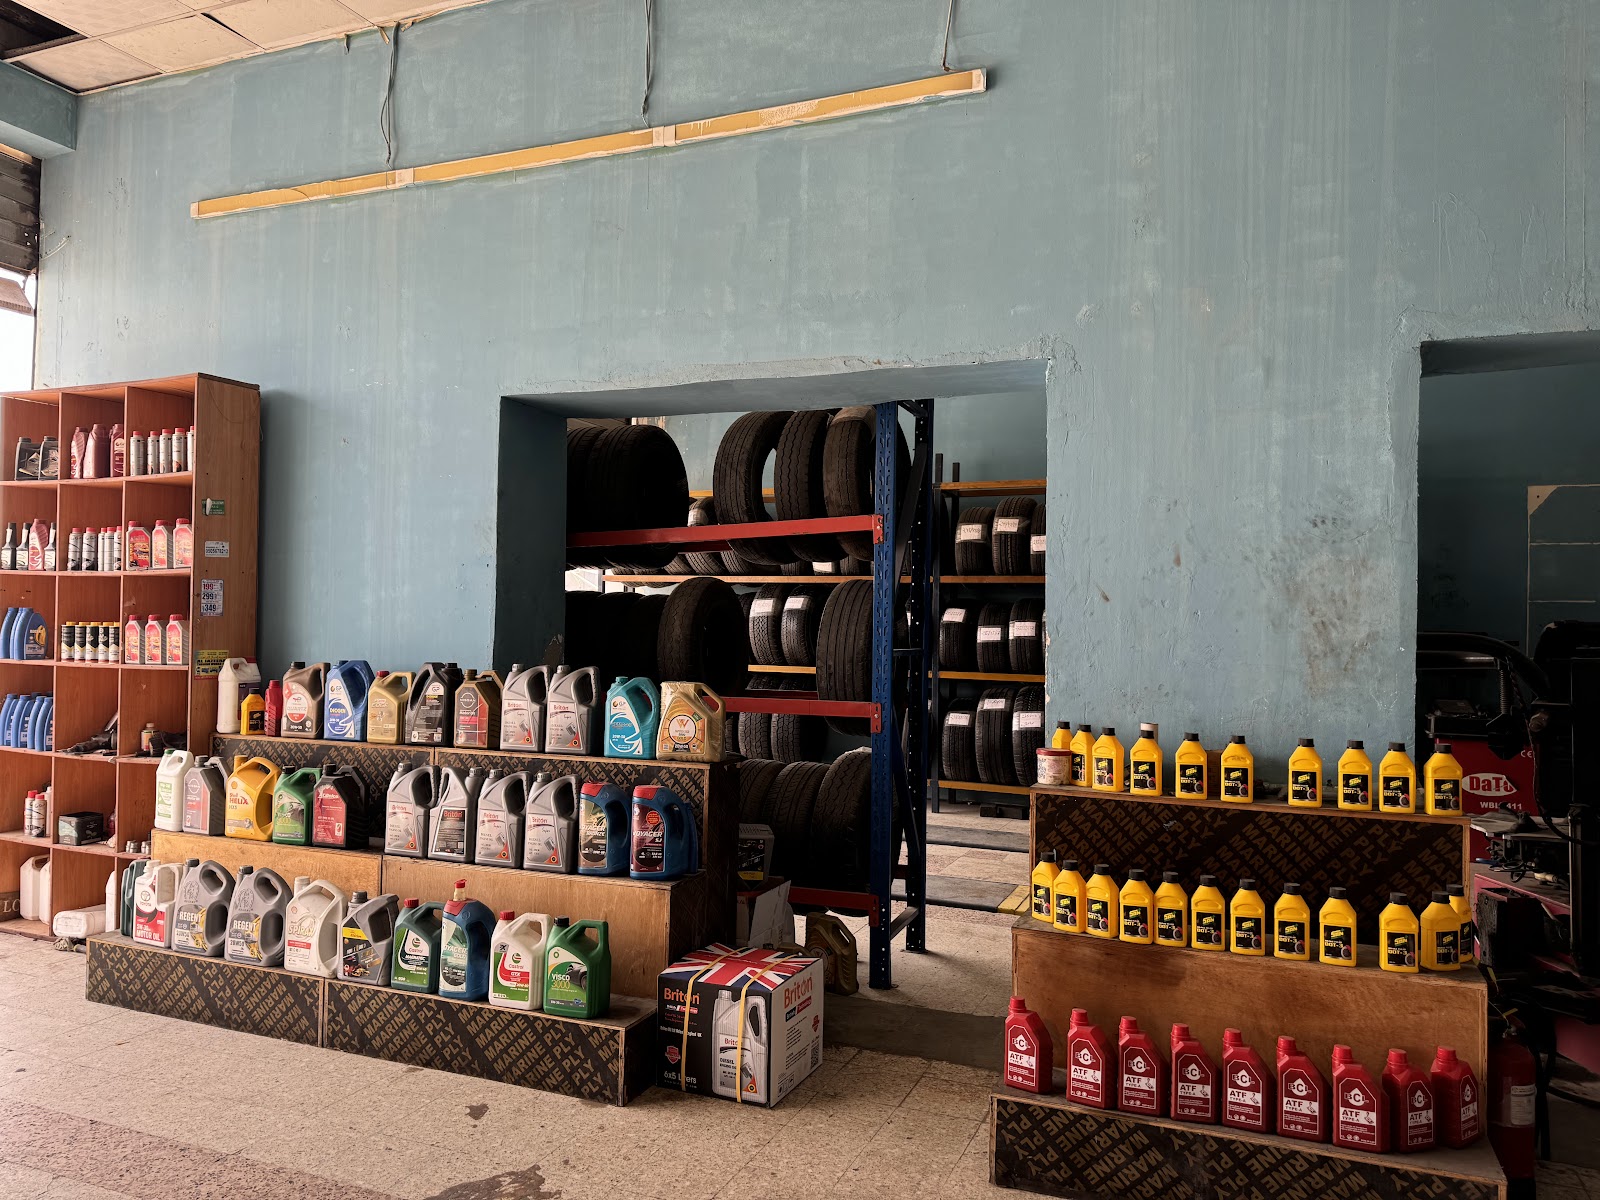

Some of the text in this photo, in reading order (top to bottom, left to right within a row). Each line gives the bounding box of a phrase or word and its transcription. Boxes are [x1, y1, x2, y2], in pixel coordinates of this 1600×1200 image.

[179, 911, 202, 923] REGENT
[233, 919, 257, 931] REGENT
[136, 930, 152, 939] MOTOR
[287, 925, 315, 938] SPIRAX
[551, 973, 571, 981] VISCO
[551, 980, 571, 989] 3000
[784, 976, 813, 1009] Briton
[1009, 1052, 1024, 1061] ATF
[1073, 1067, 1088, 1075] ATF
[663, 1070, 697, 1084] 6x5 Lers
[1126, 1076, 1142, 1084] ATF
[1180, 1084, 1196, 1092] ATF
[1229, 1089, 1247, 1098] ATF
[1285, 1099, 1303, 1108] ATF
[1342, 1108, 1360, 1118] ATF
[1409, 1112, 1423, 1121] ATF
